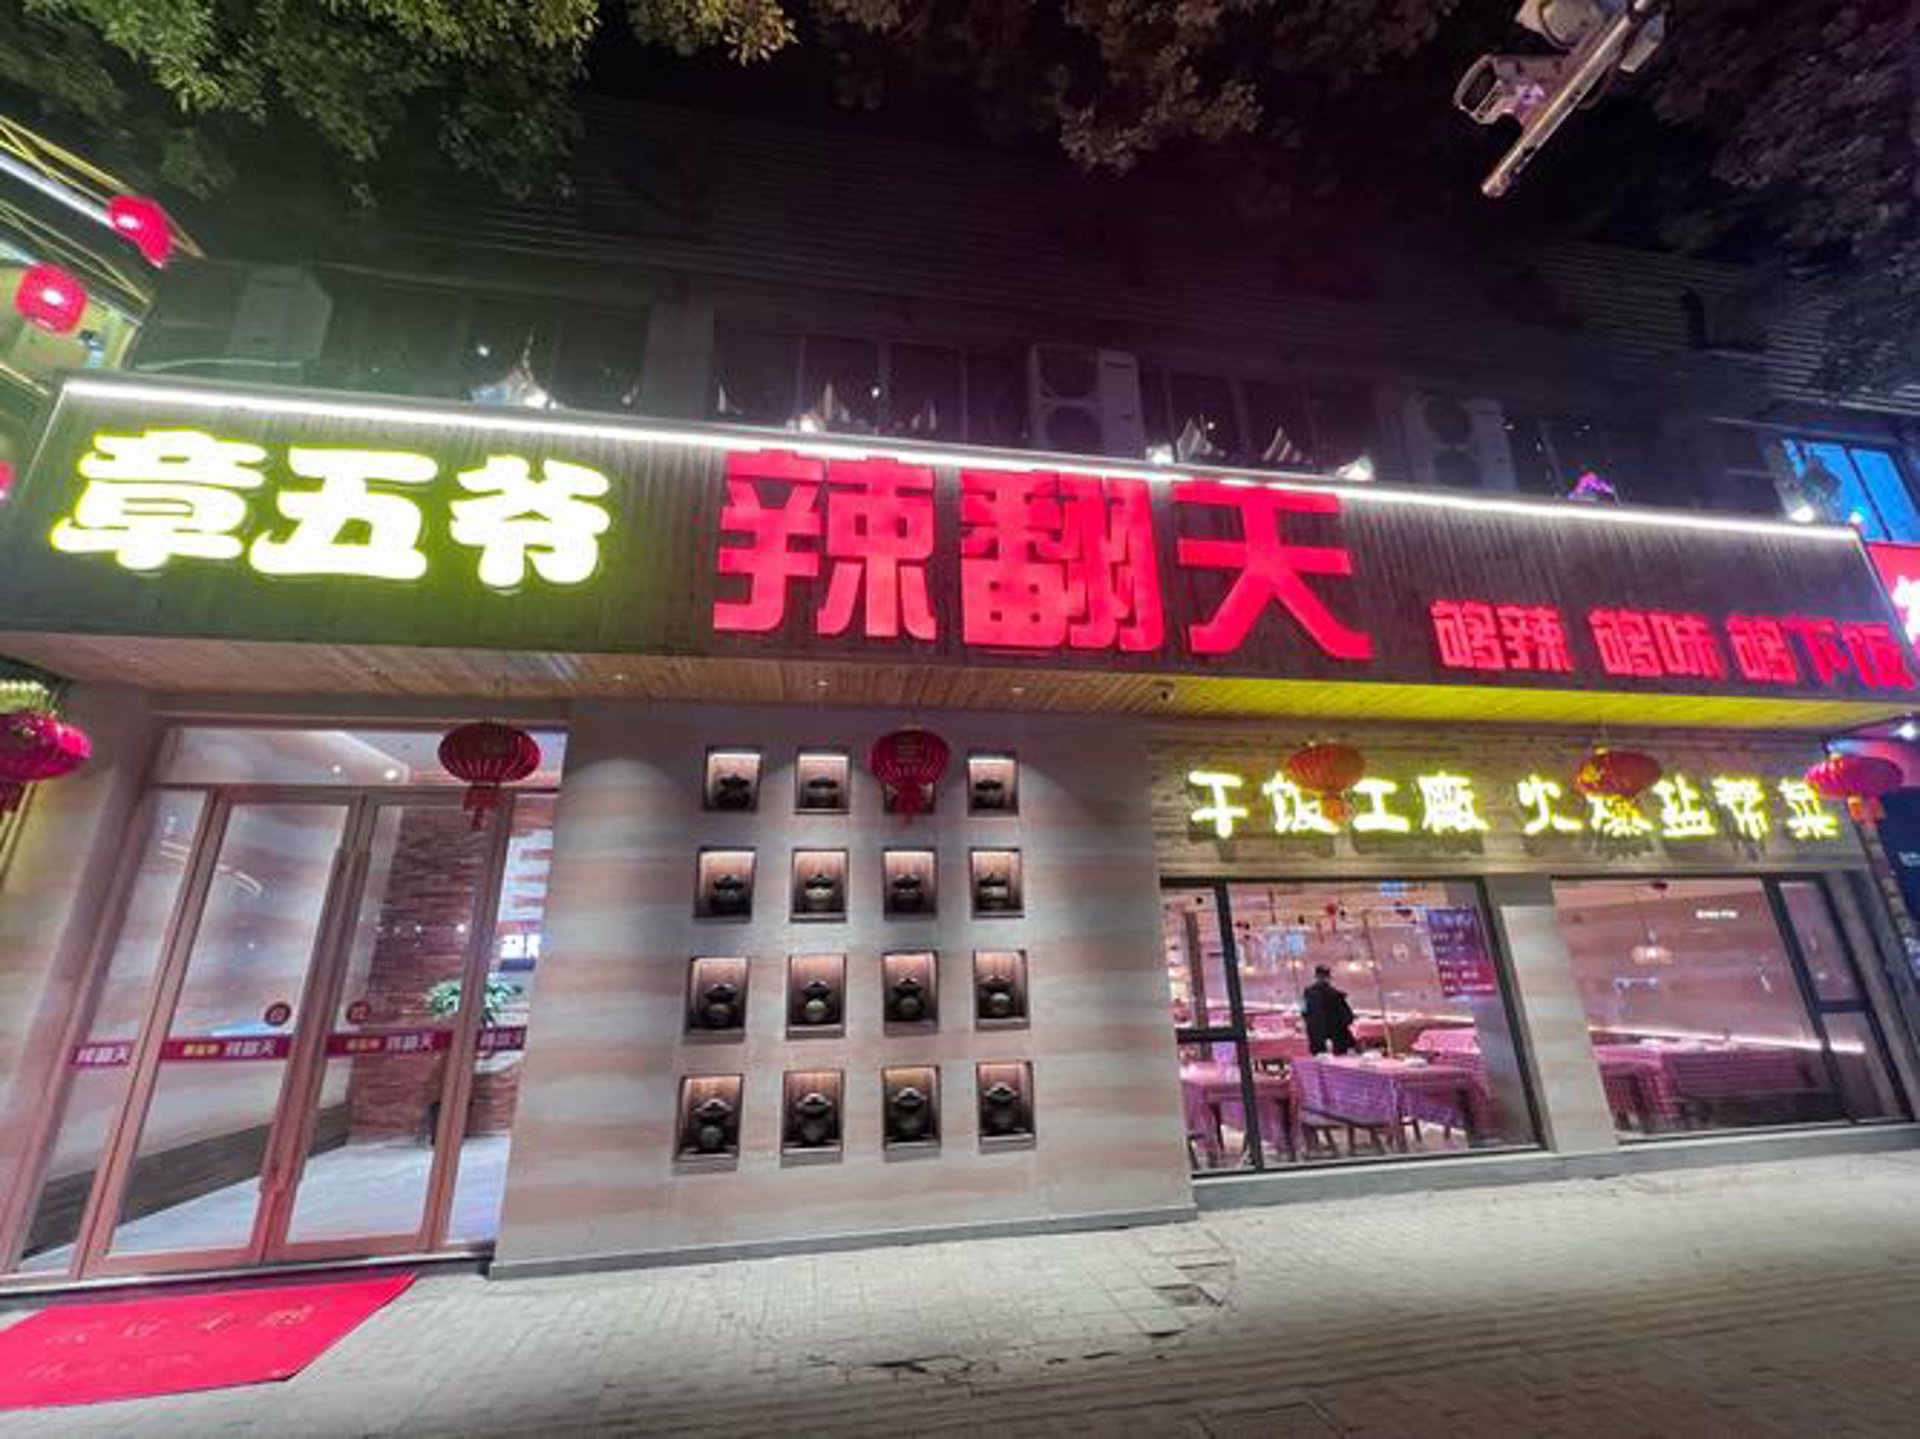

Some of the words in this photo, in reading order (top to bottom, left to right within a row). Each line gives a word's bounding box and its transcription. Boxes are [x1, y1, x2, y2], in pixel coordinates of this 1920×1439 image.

[50, 430, 610, 586] 章五爷
[713, 448, 1372, 660] 辣翻天
